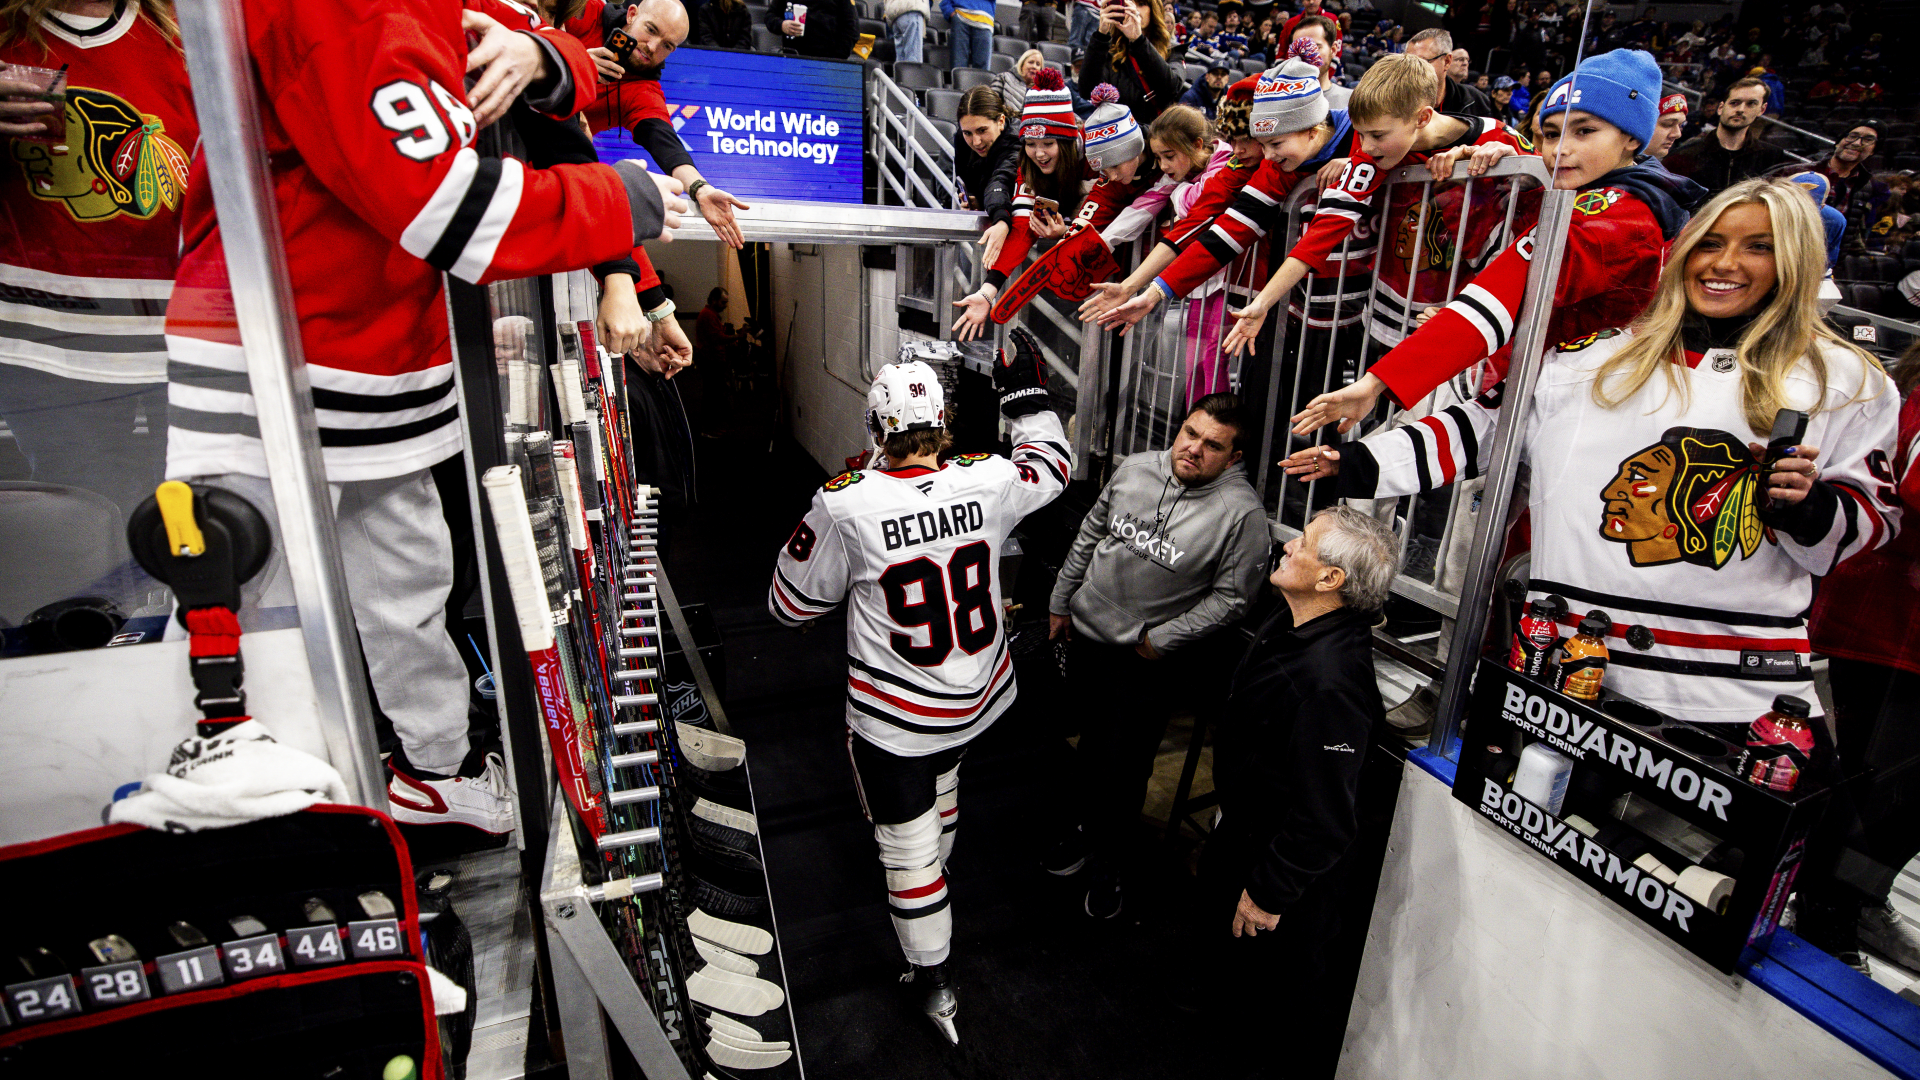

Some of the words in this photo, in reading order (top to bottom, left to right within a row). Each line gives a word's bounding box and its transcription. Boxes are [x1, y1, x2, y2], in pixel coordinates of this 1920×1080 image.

[368, 78, 478, 163] 98
[705, 106, 776, 133] World
[780, 112, 840, 137] Wide
[707, 131, 839, 165] Technology
[1337, 161, 1377, 192] 98
[1018, 264, 1051, 296] FAN
[909, 382, 926, 398] 98
[881, 501, 984, 551] BEDARD
[1111, 514, 1185, 566] HOCKEY
[1125, 543, 1150, 561] LEAGUE
[878, 540, 998, 667] 98
[539, 675, 560, 729] BAUER
[671, 692, 699, 718] NHL
[1501, 709, 1546, 739] SPORTS
[1547, 734, 1586, 761] DRINK
[1504, 681, 1733, 822] BODYARMOR
[1480, 803, 1522, 835] SPORTS
[1523, 830, 1559, 860] DRINK
[1481, 777, 1694, 933] BODYARMOR
[669, 888, 687, 932] FLYLITE
[295, 931, 339, 959] 44
[357, 926, 397, 952] 46
[176, 958, 204, 985] 11
[228, 943, 278, 973] 34
[14, 983, 72, 1018] 24
[91, 969, 141, 1000] 28
